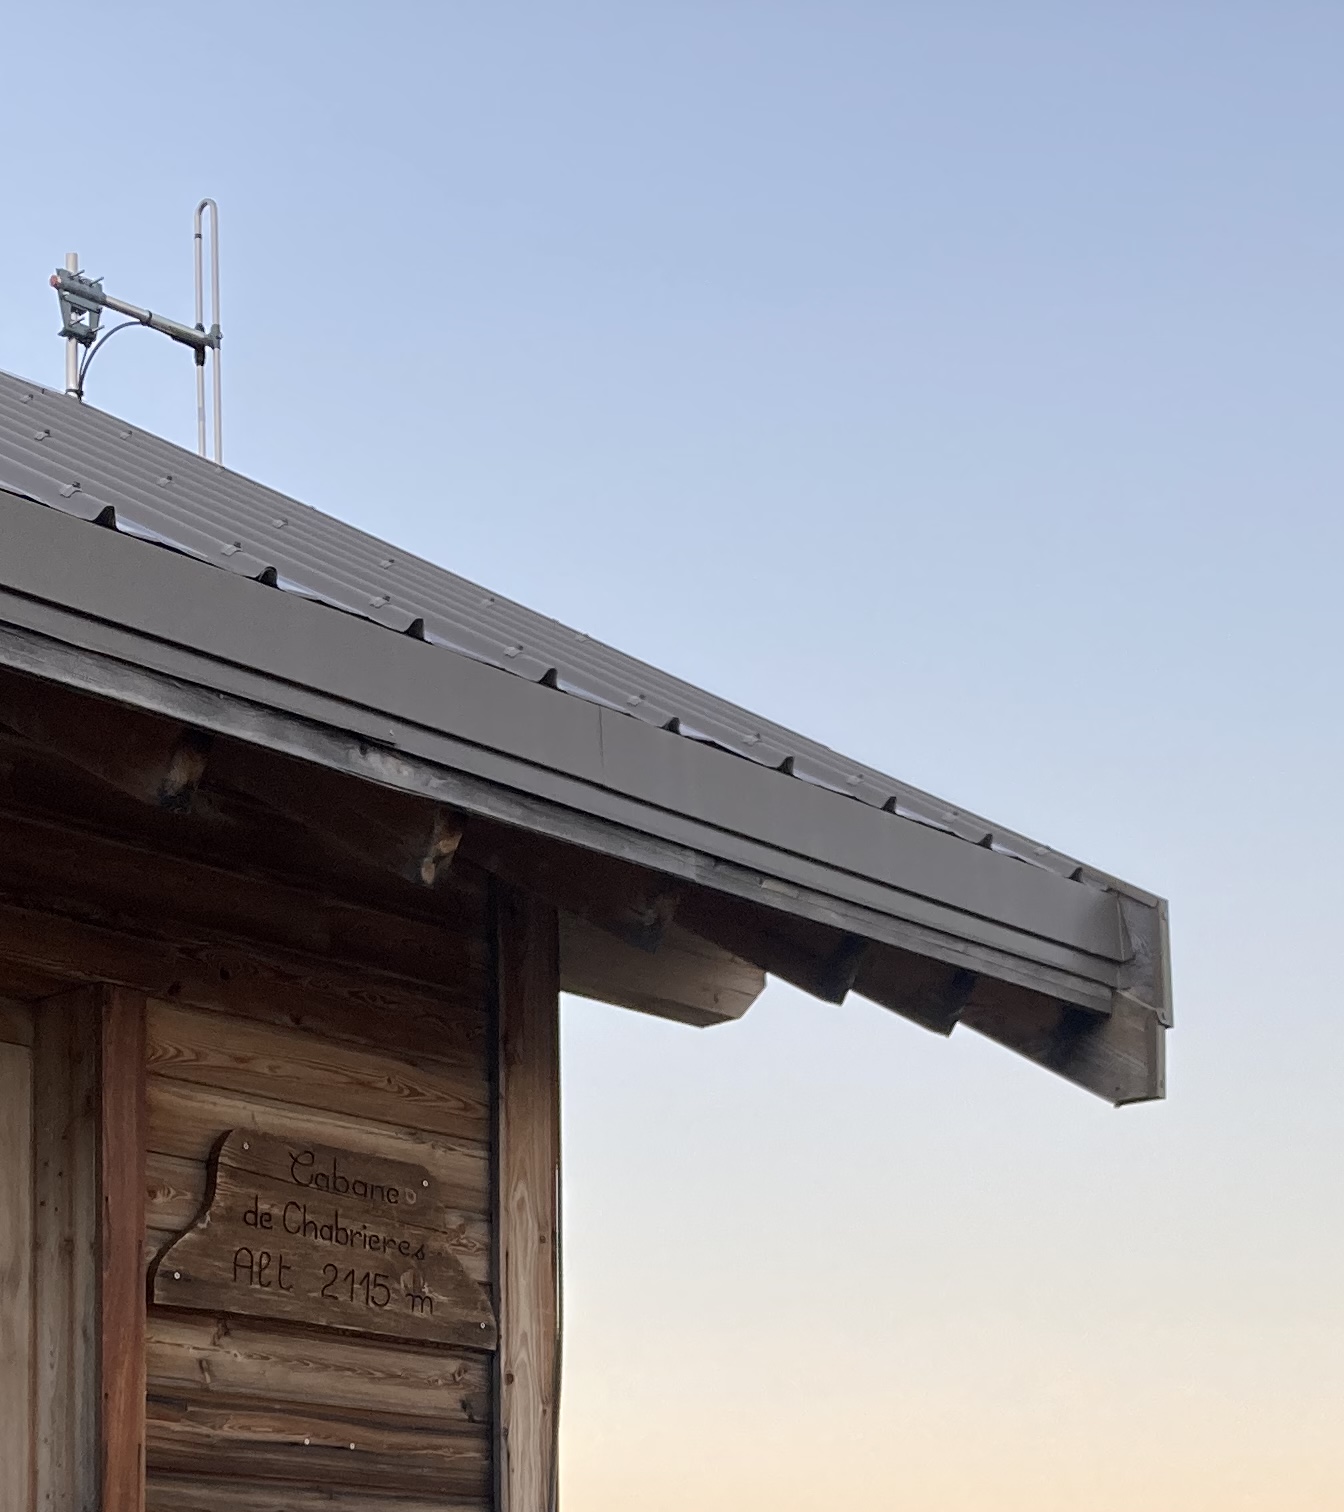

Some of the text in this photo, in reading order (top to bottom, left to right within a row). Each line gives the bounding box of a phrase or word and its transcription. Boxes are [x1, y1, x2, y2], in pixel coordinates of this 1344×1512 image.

[288, 1150, 400, 1205] Cabane
[243, 1195, 426, 1261] de Chabrieres
[233, 1246, 434, 1315] Alt 2115 m
